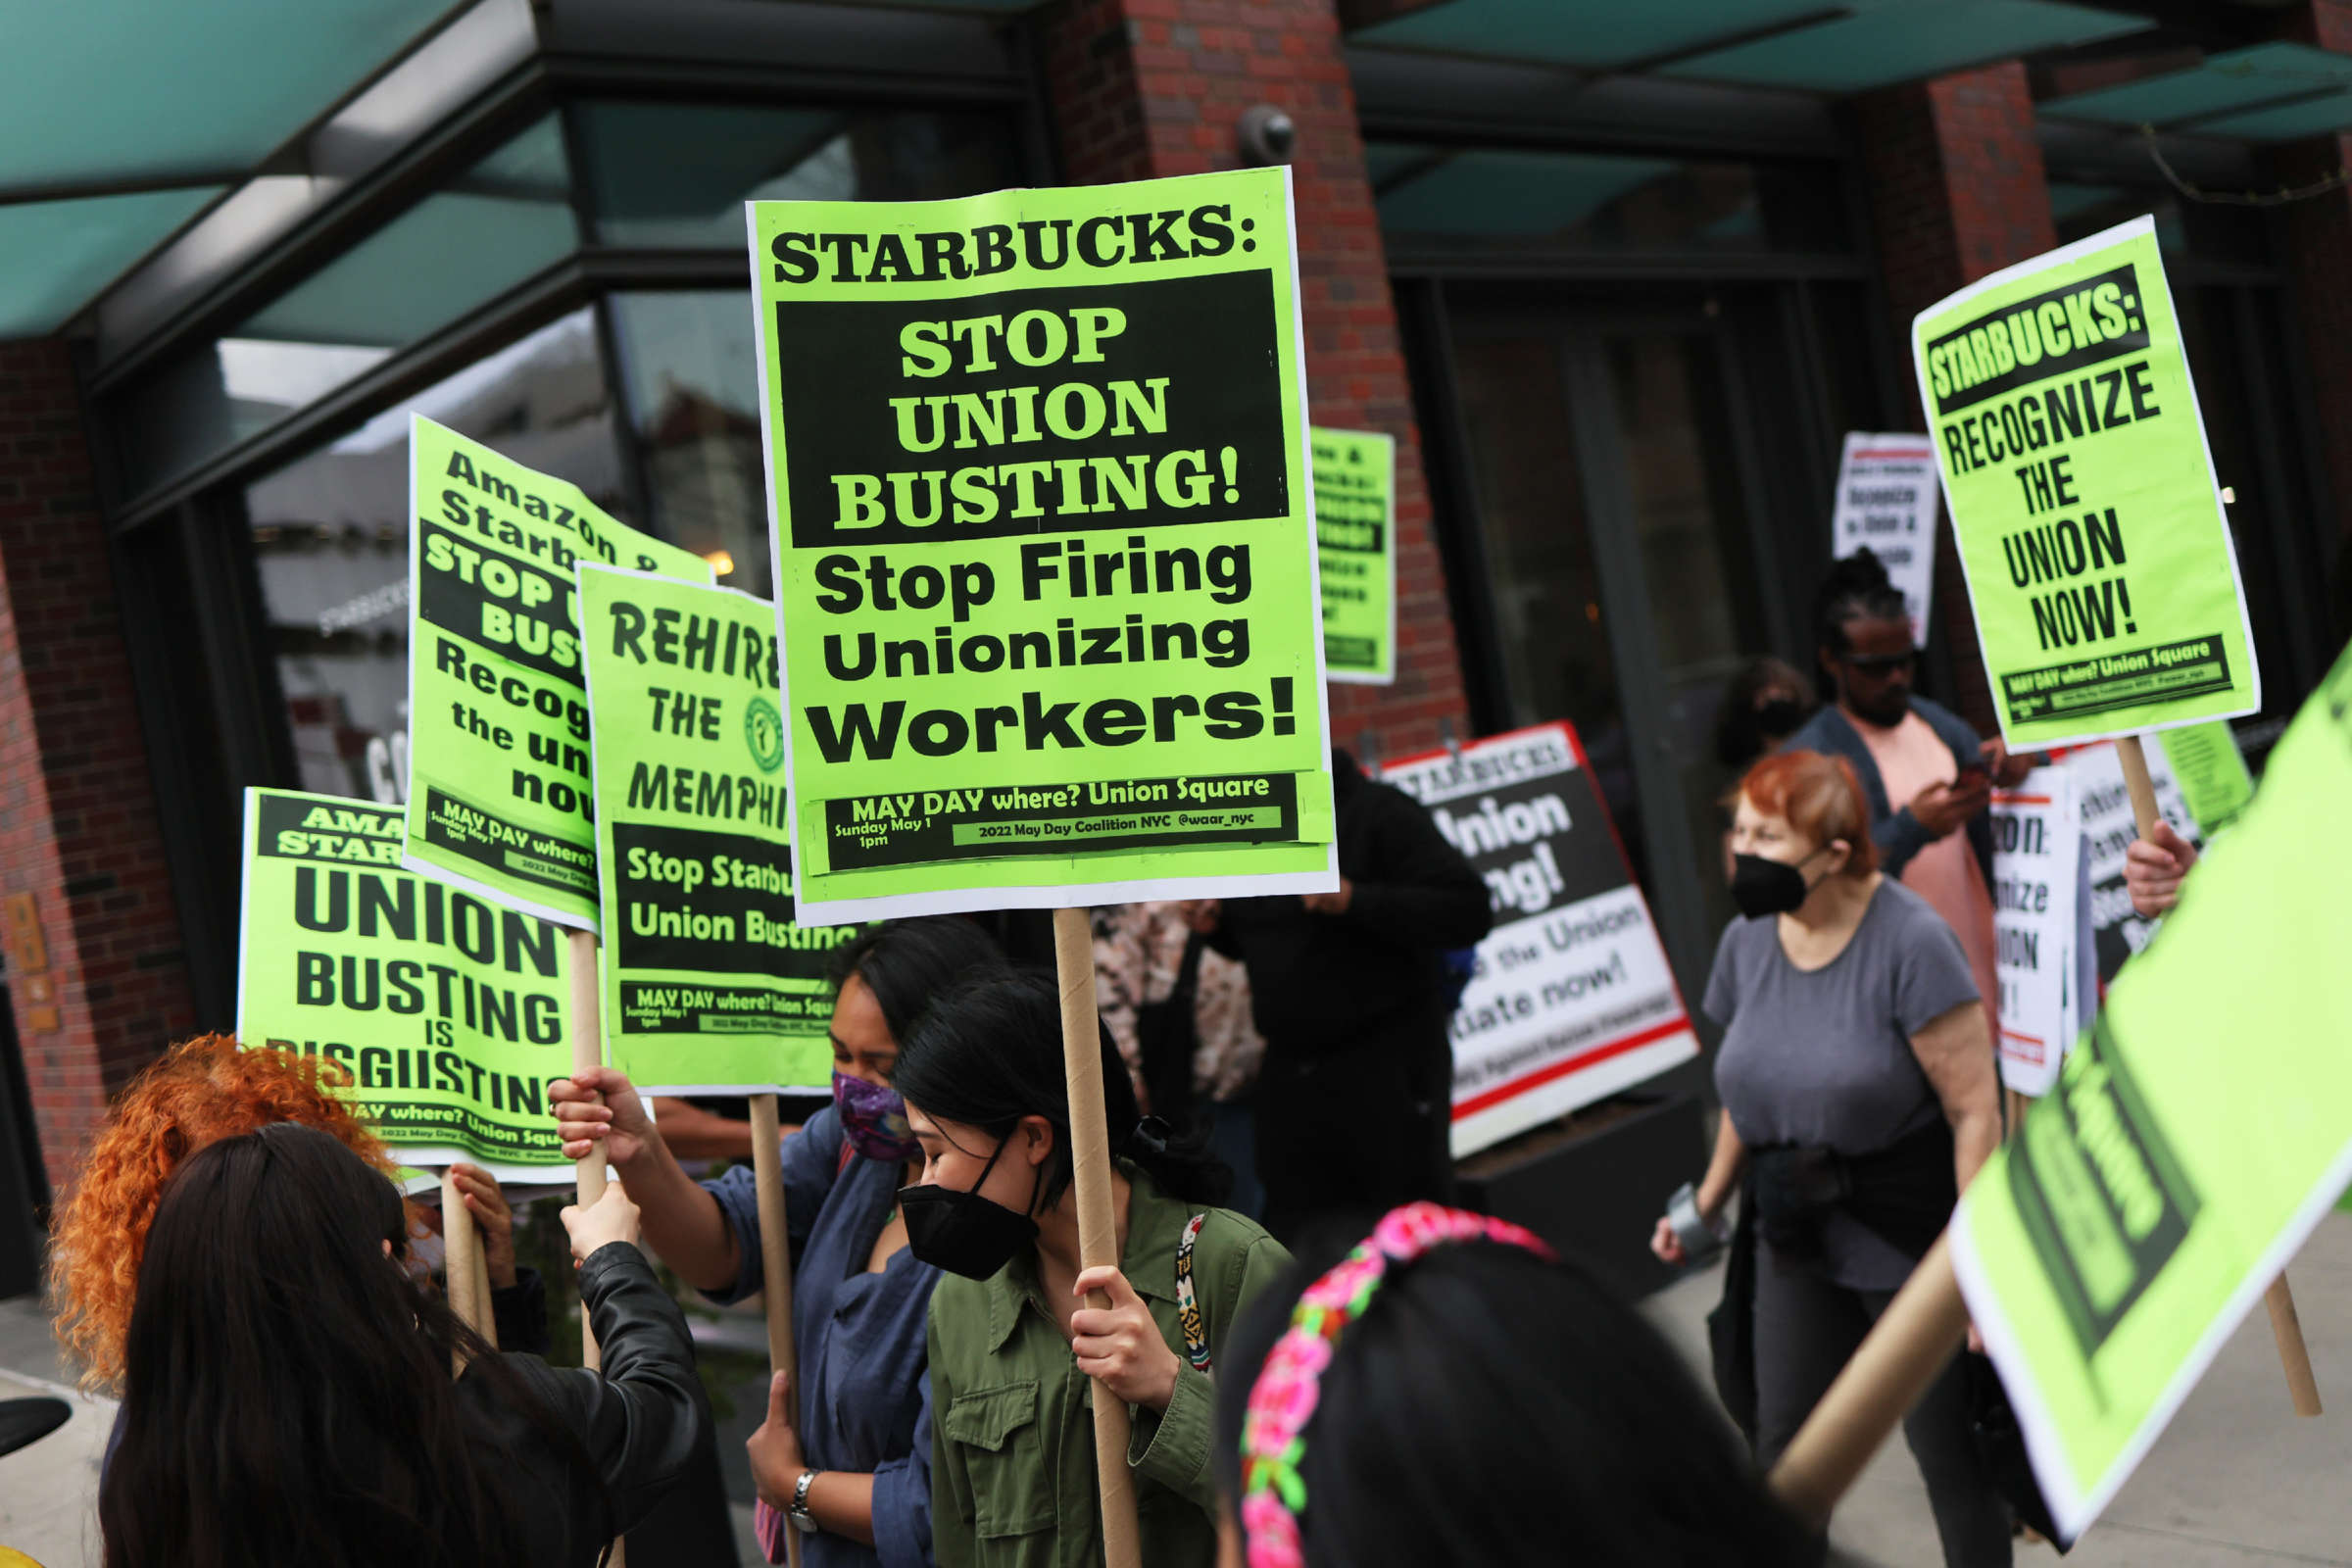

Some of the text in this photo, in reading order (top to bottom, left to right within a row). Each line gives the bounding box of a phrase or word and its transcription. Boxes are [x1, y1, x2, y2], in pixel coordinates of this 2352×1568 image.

[771, 204, 1256, 283] STARBUCKS:
[900, 308, 1127, 377] STOP
[1930, 282, 2140, 399] STARBUCKS:
[890, 378, 1170, 453] UNION
[1943, 361, 2161, 475] RECOGNIZE
[446, 451, 616, 564] Amazon
[831, 446, 1240, 530] BUSTING!
[2015, 455, 2080, 515] THE
[442, 489, 580, 572] Starb
[2003, 508, 2126, 588] UNION
[425, 533, 553, 609] STOP
[815, 536, 1252, 622] Stop Firing
[482, 601, 580, 668] BUS
[823, 614, 1251, 682] Unionizing
[2031, 578, 2137, 650] NOW!
[2100, 654, 2148, 676] Union
[2150, 642, 2211, 667] Square
[452, 702, 514, 750] the
[648, 687, 721, 742] THE
[806, 677, 1297, 764] Workers!
[431, 810, 466, 833] Sunday
[467, 826, 487, 843] May
[835, 817, 931, 837] Sunday May 1
[853, 777, 1269, 822] MAY DAY where? Union Square
[979, 813, 1254, 838] 2022 May Day Coalition NYC @waar_nyc
[444, 800, 595, 869] MAY DAY where?
[446, 827, 466, 842] 1pm
[859, 835, 888, 850] 1pm
[627, 847, 704, 894] Stop
[295, 866, 558, 978] UNION
[631, 903, 735, 941] Union
[297, 951, 563, 1045] BUSTING
[637, 989, 678, 1007] MAY
[681, 991, 714, 1008] DAY
[716, 993, 771, 1010] where?
[425, 1019, 454, 1048] IS
[345, 1103, 564, 1147] AY where? Union Squ
